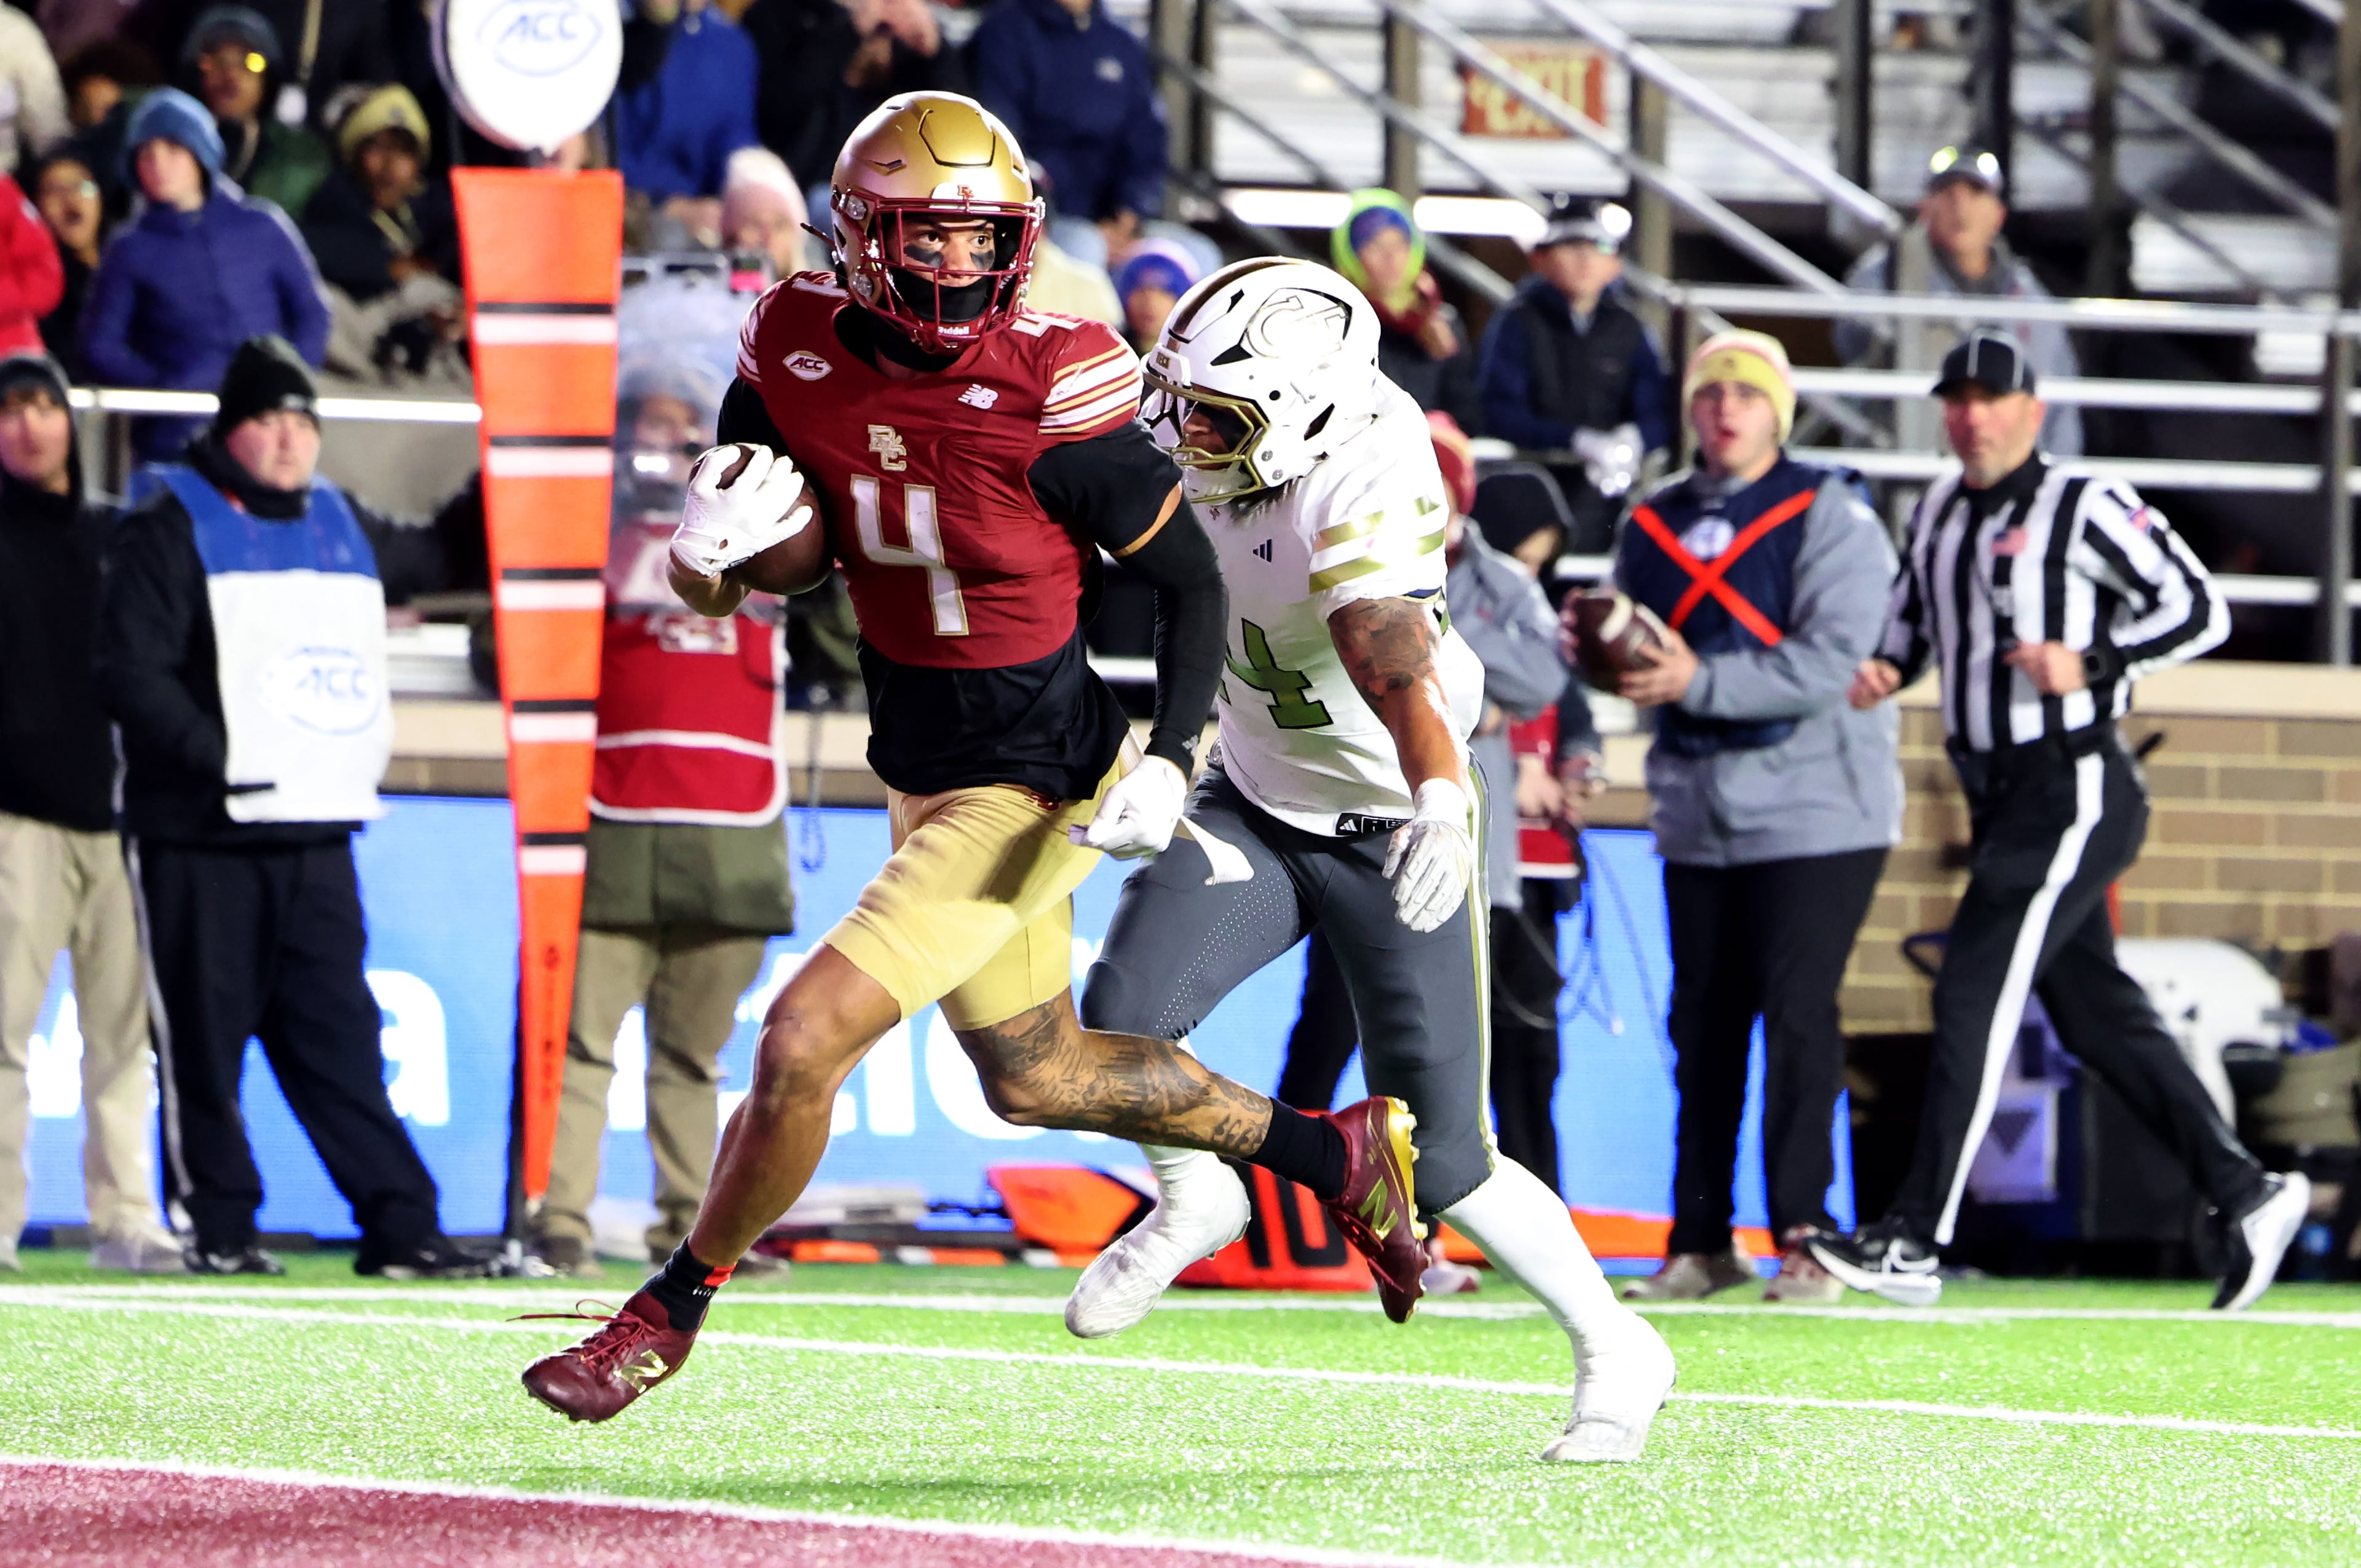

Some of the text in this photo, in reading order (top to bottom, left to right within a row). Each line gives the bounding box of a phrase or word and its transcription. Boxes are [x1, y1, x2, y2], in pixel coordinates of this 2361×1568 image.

[790, 357, 825, 371] ACC
[851, 474, 970, 636] 4
[1216, 617, 1334, 729] 4
